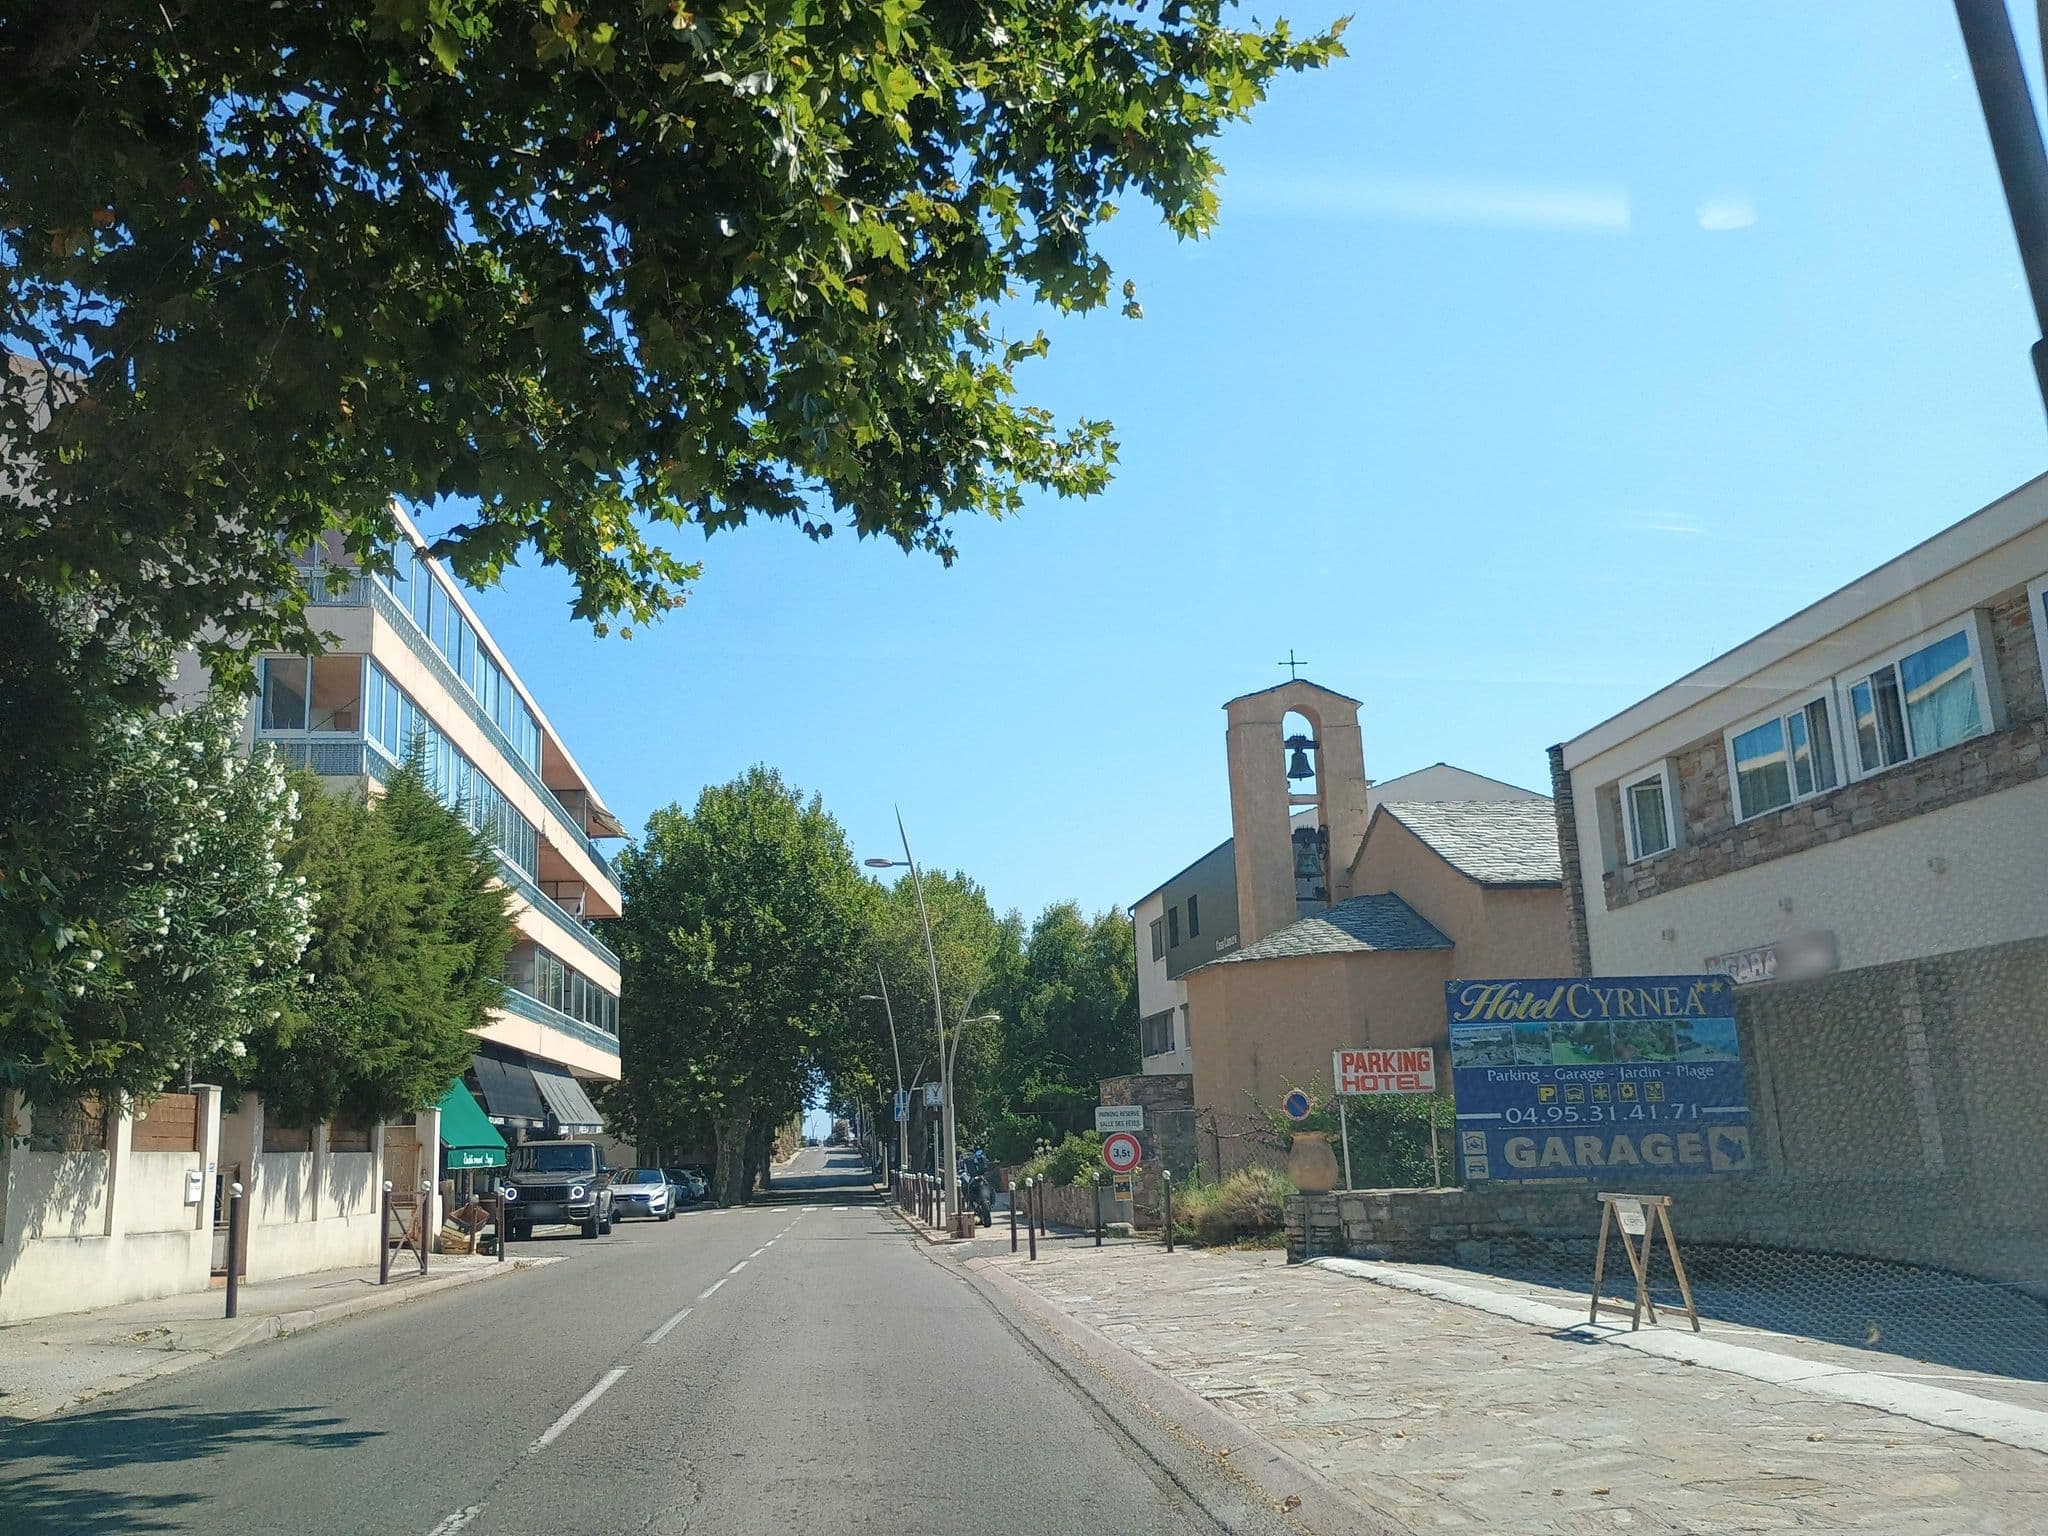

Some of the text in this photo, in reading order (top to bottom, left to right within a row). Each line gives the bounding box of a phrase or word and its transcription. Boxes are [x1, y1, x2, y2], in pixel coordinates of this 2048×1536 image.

[1453, 982, 1708, 1021] Hôtel CYRNEA
[1341, 1051, 1430, 1073] PARKING
[1341, 1074, 1433, 1091] HOTEL
[1487, 1065, 1714, 1084] Parking Garage Jardin Plage
[1505, 1104, 1698, 1124] 04.95.31.41.71
[1113, 1148, 1131, 1159] 3,5t
[1504, 1132, 1705, 1168] GARAGE
